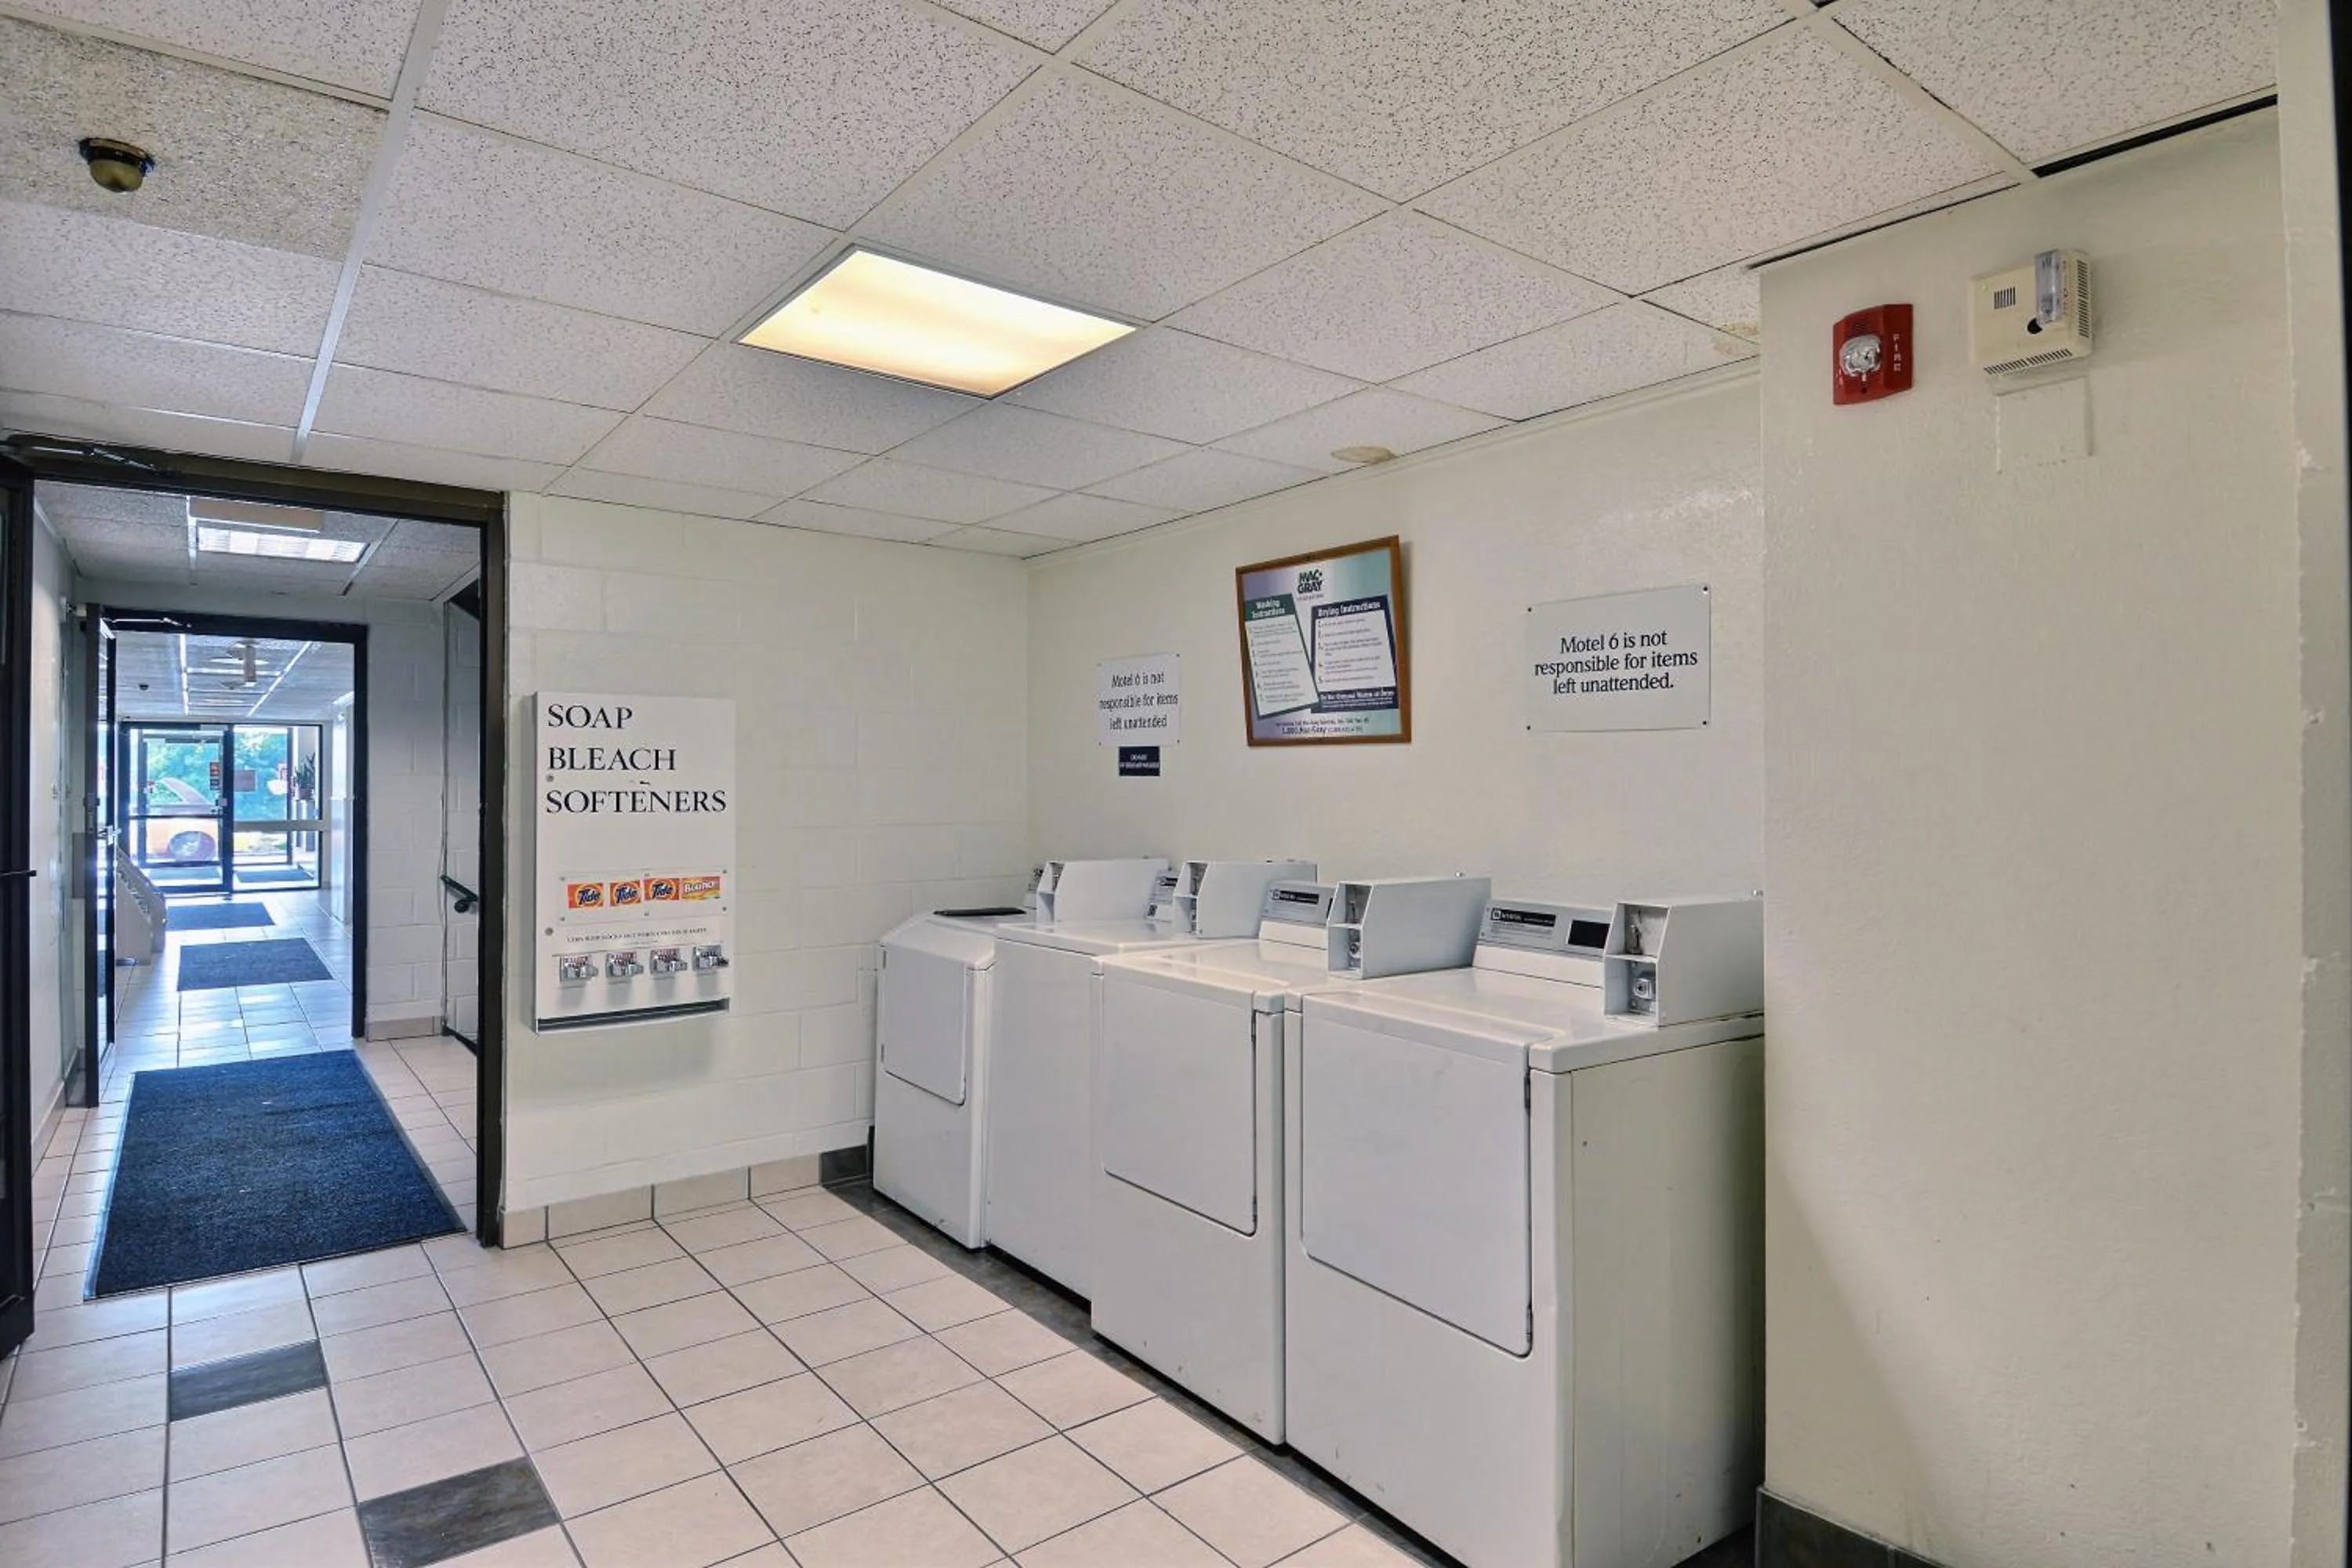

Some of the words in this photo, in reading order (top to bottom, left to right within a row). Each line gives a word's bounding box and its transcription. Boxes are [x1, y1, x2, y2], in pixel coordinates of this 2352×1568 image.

[1560, 634, 1604, 654] Motel
[1609, 633, 1619, 650] 6
[1624, 632, 1635, 648] is
[1640, 630, 1668, 647] not
[1534, 655, 1620, 677] responsible
[1624, 653, 1646, 670] for
[1651, 652, 1697, 667] items
[1112, 673, 1133, 688] Motel
[1142, 672, 1149, 684] is
[1150, 673, 1164, 684] not
[1553, 678, 1576, 694] left
[1581, 673, 1674, 693] unattended.
[1100, 694, 1141, 712] responsible
[1143, 693, 1155, 706] for
[1156, 692, 1178, 705] items
[548, 704, 633, 729] SOAP
[1110, 717, 1122, 730] left
[548, 747, 677, 771] BLEACH
[546, 790, 727, 813] SOFTENERS
[578, 888, 601, 905] Tide
[615, 887, 637, 903] Tide
[652, 882, 673, 899] Tide
